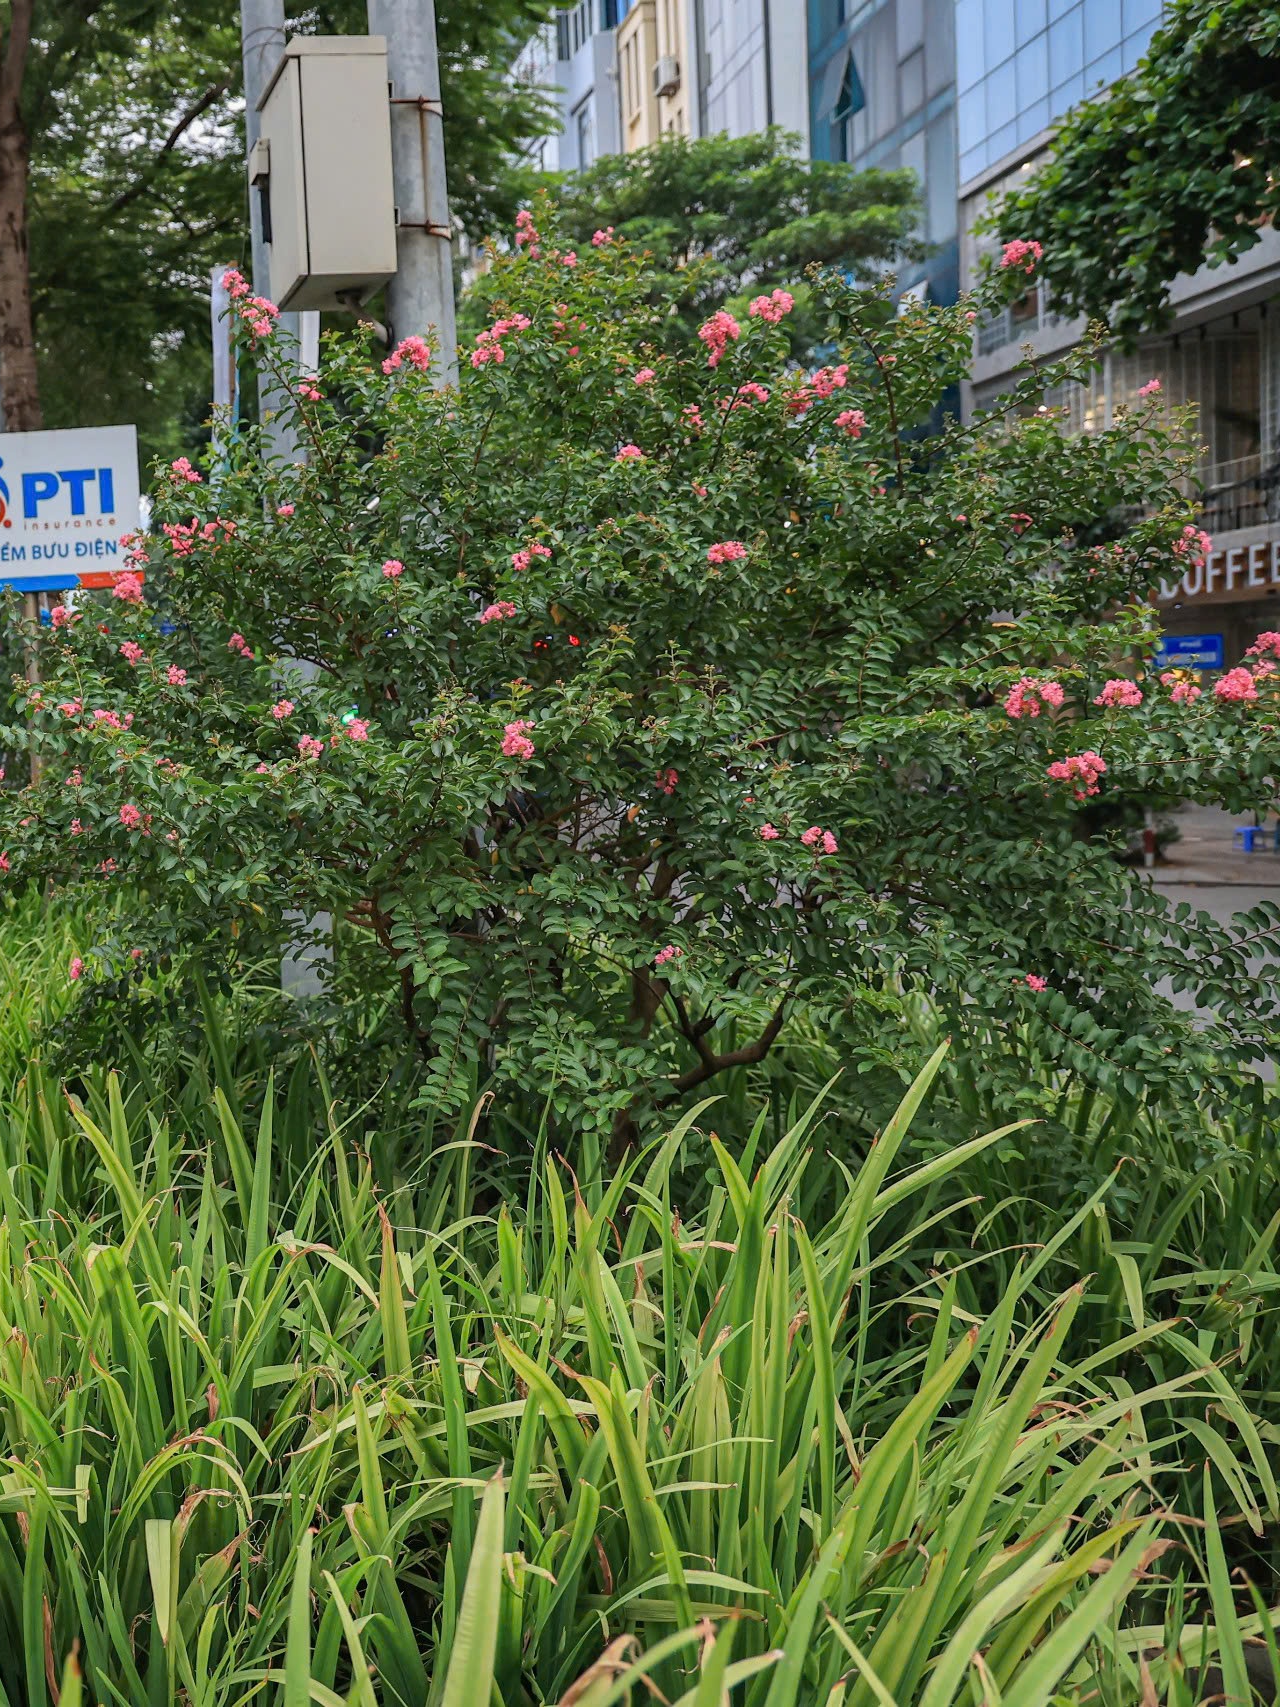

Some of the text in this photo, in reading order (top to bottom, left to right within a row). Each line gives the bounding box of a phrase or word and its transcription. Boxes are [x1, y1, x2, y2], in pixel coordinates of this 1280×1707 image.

[22, 468, 114, 518] PTI
[24, 517, 116, 531] insurance
[32, 542, 69, 560] BƯU
[75, 537, 118, 561] ĐIỆN
